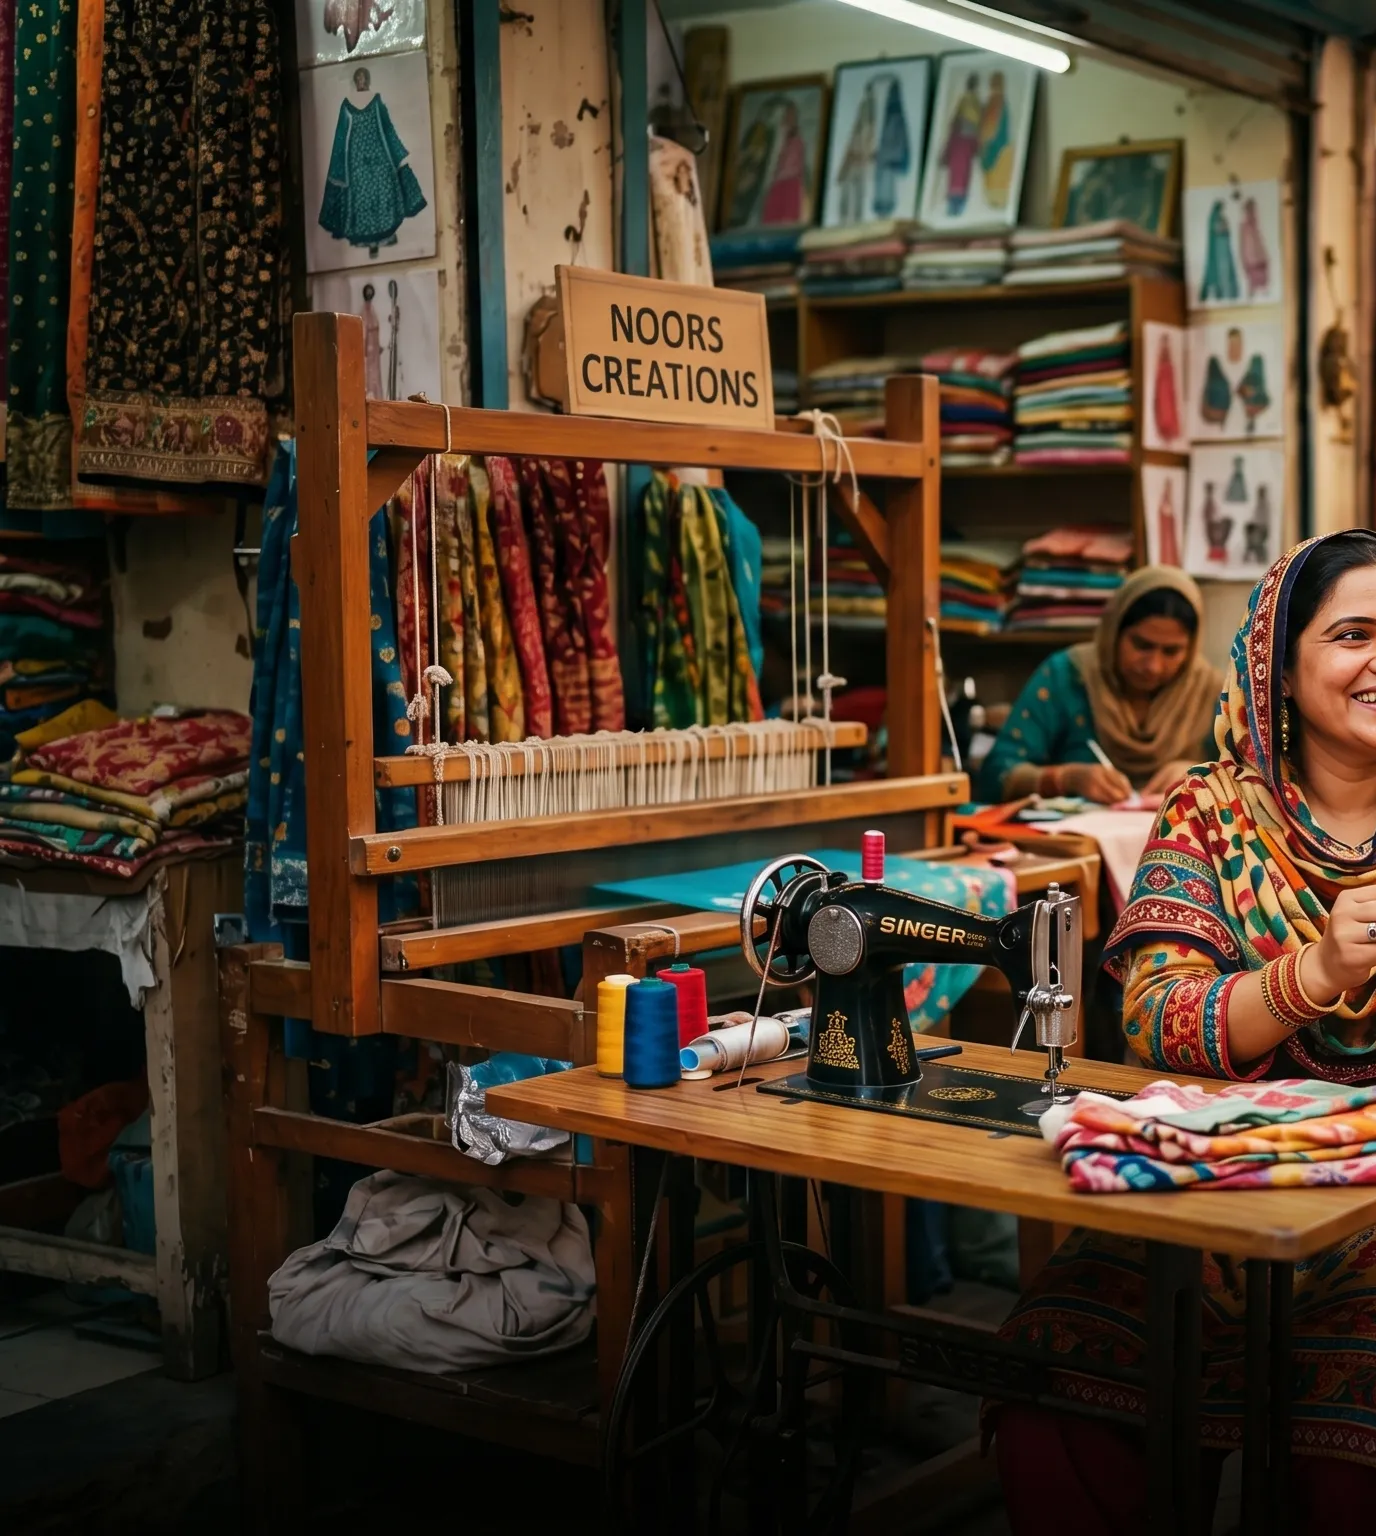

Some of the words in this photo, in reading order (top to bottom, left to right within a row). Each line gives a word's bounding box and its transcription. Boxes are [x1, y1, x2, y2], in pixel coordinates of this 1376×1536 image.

[611, 303, 724, 354] NOORS
[582, 353, 759, 409] CREATIONS
[880, 916, 966, 945] SINGER
